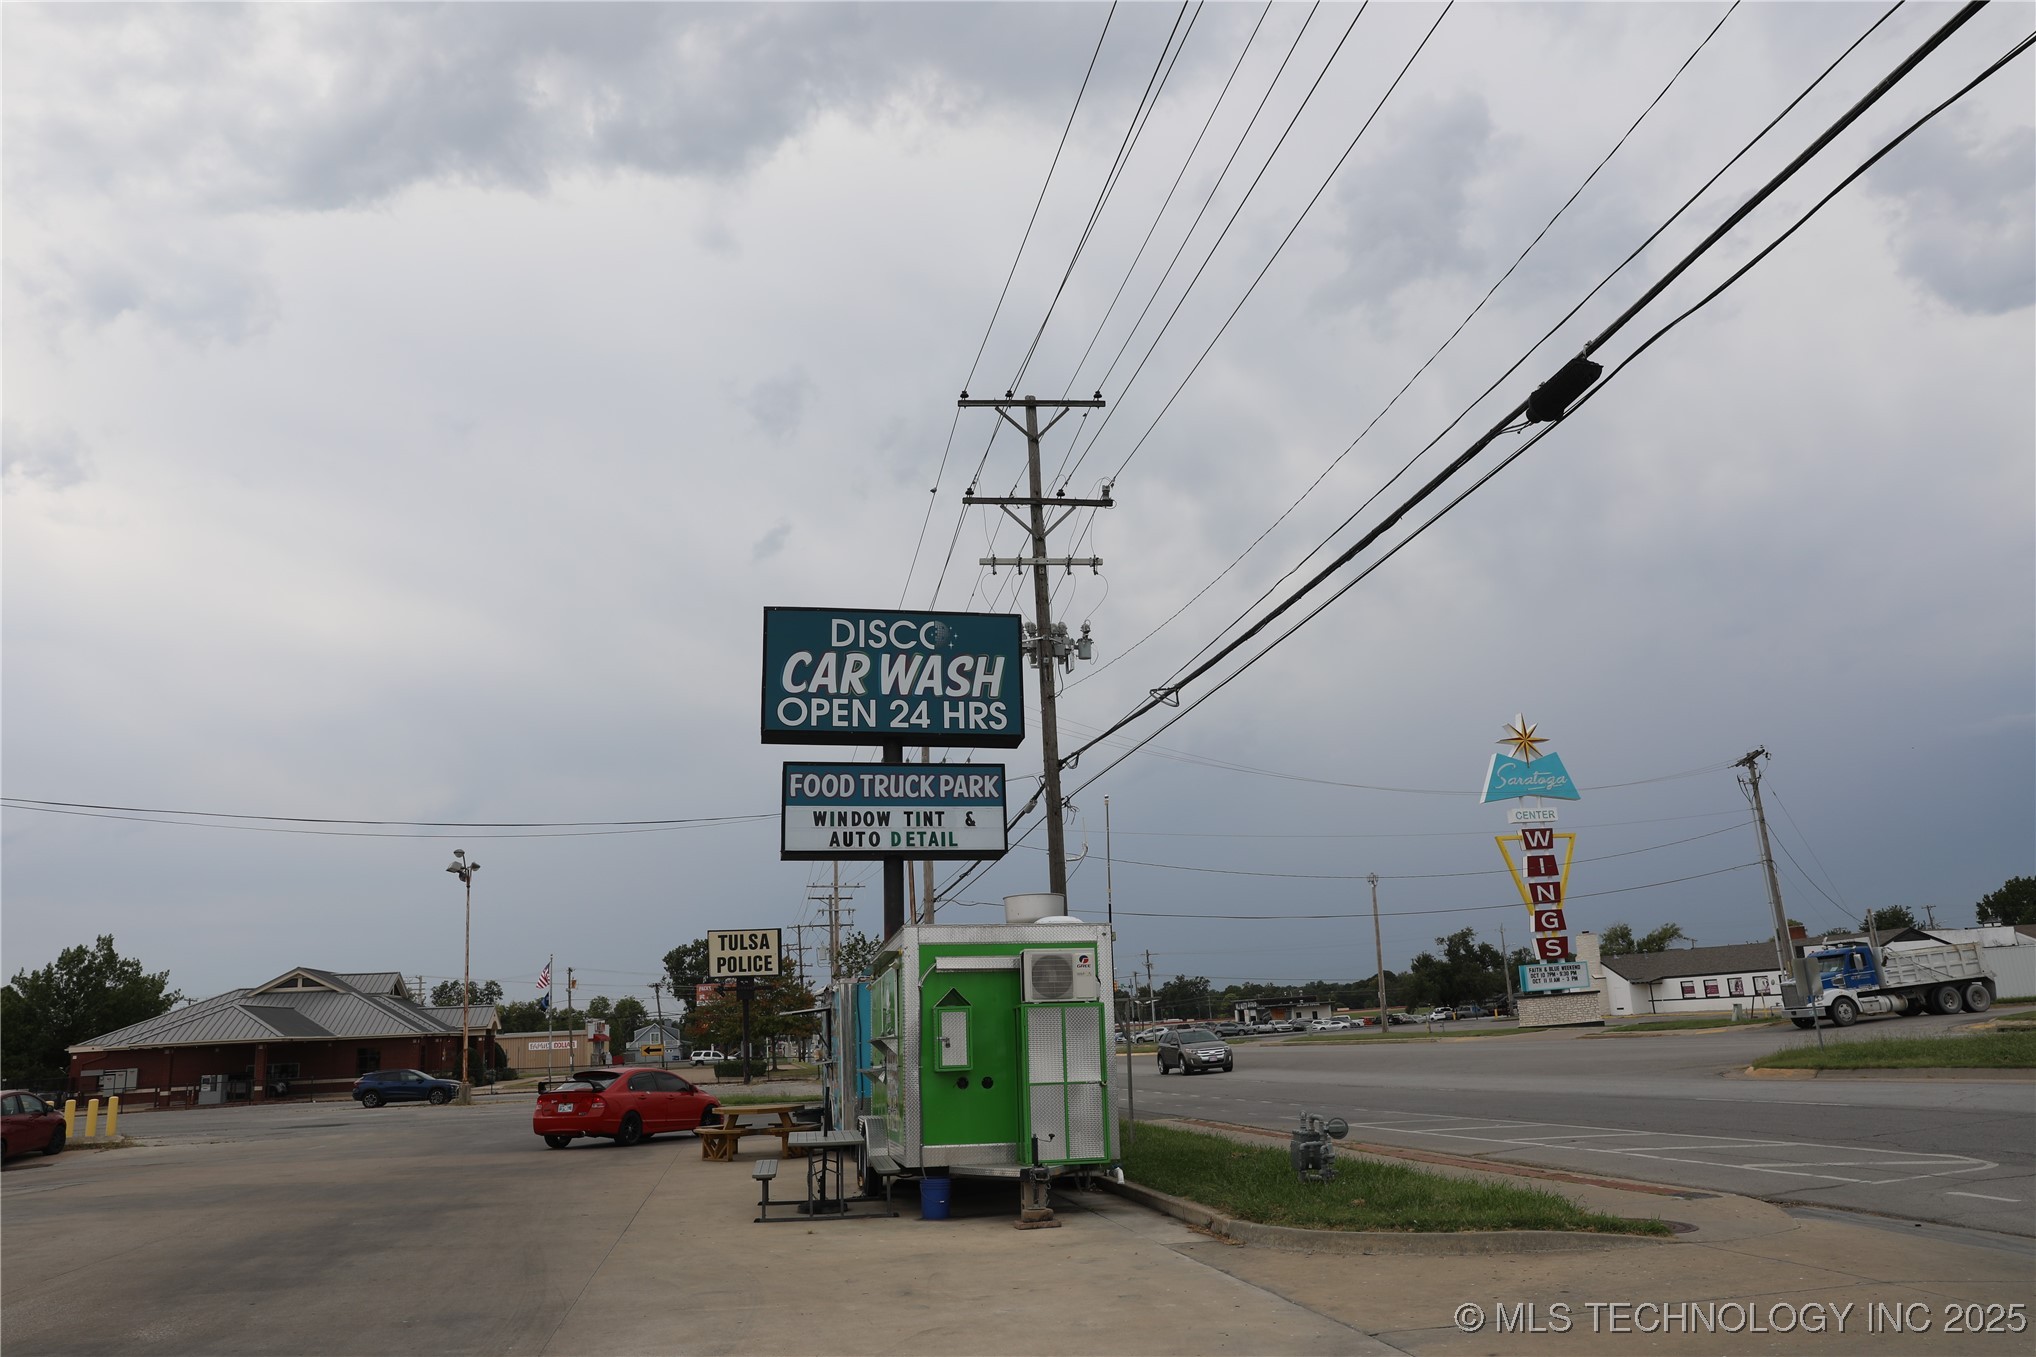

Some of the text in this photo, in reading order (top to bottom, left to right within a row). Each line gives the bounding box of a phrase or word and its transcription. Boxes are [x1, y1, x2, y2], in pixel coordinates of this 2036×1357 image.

[832, 618, 951, 650] DISCO
[782, 651, 1006, 698] CAR WASH
[777, 697, 1008, 730] OPEN 24 HRS
[789, 773, 1000, 799] FOOD TRUCK PARK
[1495, 762, 1568, 790] Saratoga
[813, 811, 976, 827] WINDOW TINT &
[1515, 810, 1556, 820] CENTER
[829, 831, 958, 847] AUTO DETAIL
[1525, 830, 1563, 957] WINGS
[717, 933, 770, 951] TULSA
[717, 955, 773, 973] POLICE
